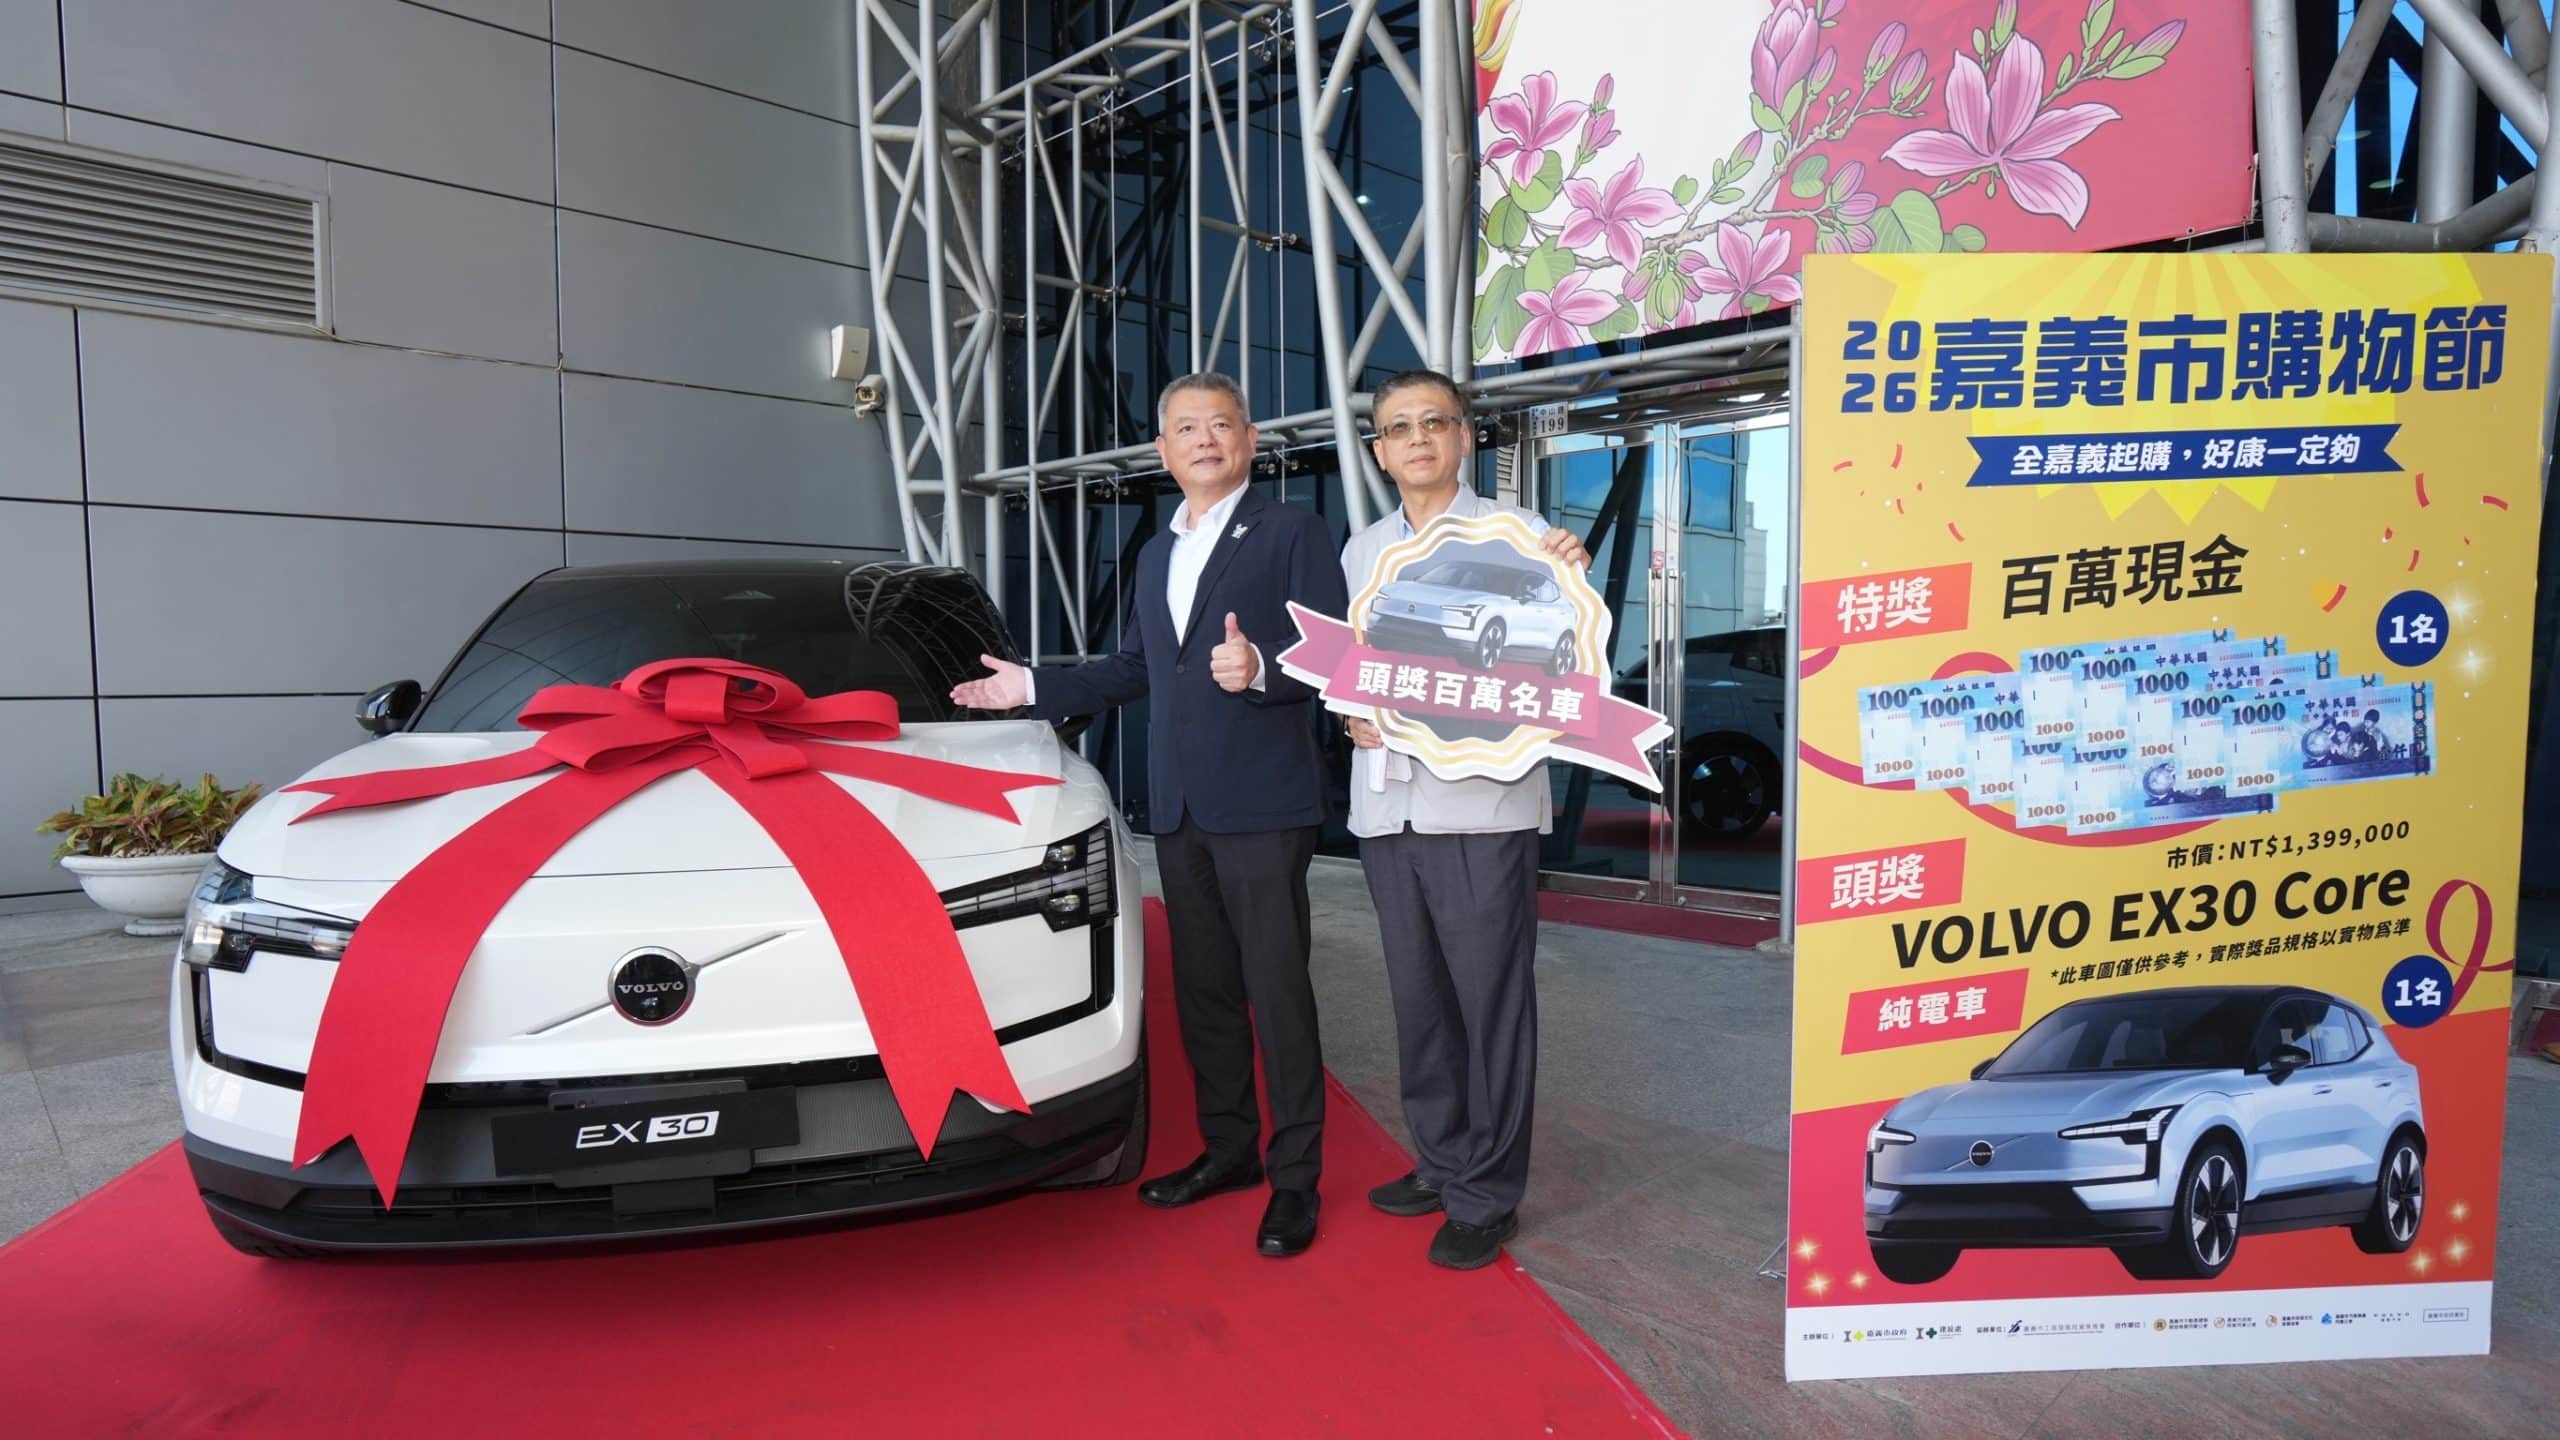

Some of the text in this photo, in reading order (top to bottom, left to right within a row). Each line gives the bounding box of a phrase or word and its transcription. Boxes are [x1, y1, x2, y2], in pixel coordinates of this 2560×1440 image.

[1843, 320, 1922, 361] 20
[1930, 304, 2507, 412] 嘉義市購物節
[1840, 371, 1918, 413] 26
[1541, 416, 1564, 433] 199
[2011, 433, 2360, 477] 全嘉義起購，好康一定夠
[2000, 532, 2250, 620] 百萬現金
[1836, 575, 1934, 634] 特獎
[2388, 613, 2438, 646] 1名
[1355, 660, 1585, 724] 頭獎百萬名車
[2134, 670, 2189, 695] 1000
[2036, 721, 2074, 735] 1000
[2232, 702, 2286, 726] 1000
[2088, 729, 2125, 743] 1000
[1875, 760, 1913, 774] 1000
[1927, 767, 1965, 781] 1000
[2187, 766, 2224, 780] 1000
[2237, 773, 2274, 787] 1000
[2027, 804, 2065, 819] 1000
[2078, 811, 2116, 826] 1000
[1831, 854, 1925, 910] 頭獎
[1890, 867, 2411, 970] VOLVO EX30 Core
[618, 981, 684, 994] VOLVO
[2394, 978, 2443, 1009] 1名
[1878, 986, 1987, 1033] 純電車
